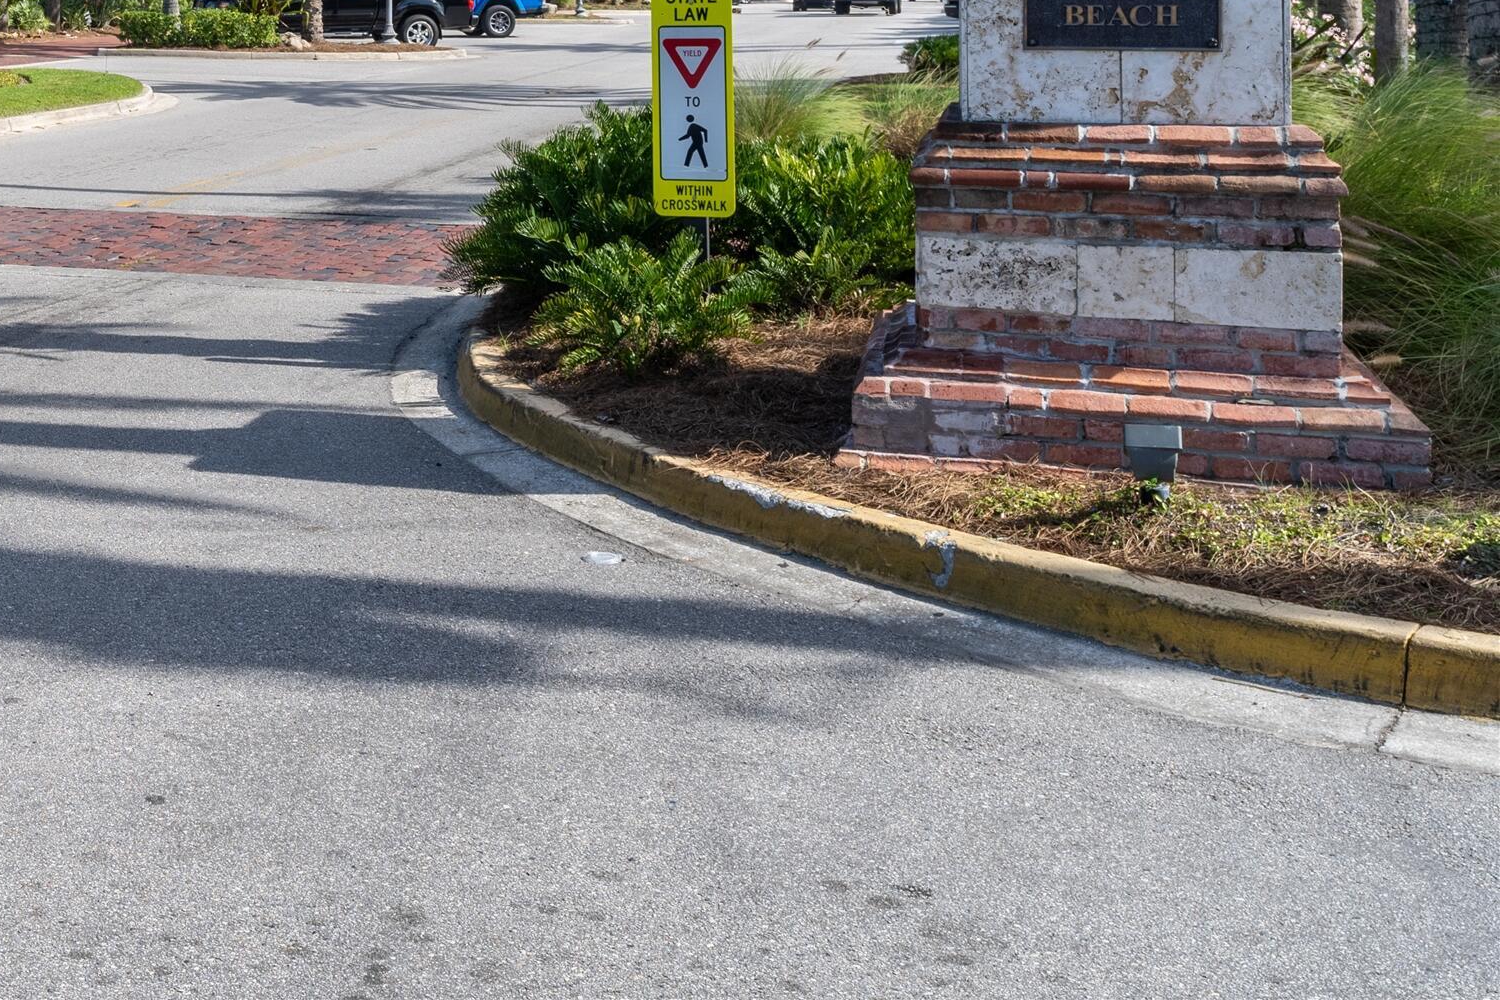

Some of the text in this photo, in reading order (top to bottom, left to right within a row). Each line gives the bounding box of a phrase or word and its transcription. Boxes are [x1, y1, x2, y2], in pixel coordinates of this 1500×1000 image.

[674, 7, 709, 21] LAW
[1064, 4, 1180, 27] BEACH
[683, 49, 703, 57] YIELD
[685, 96, 701, 107] TO
[675, 185, 713, 196] WITHIN
[661, 199, 727, 211] CROSSWALK
